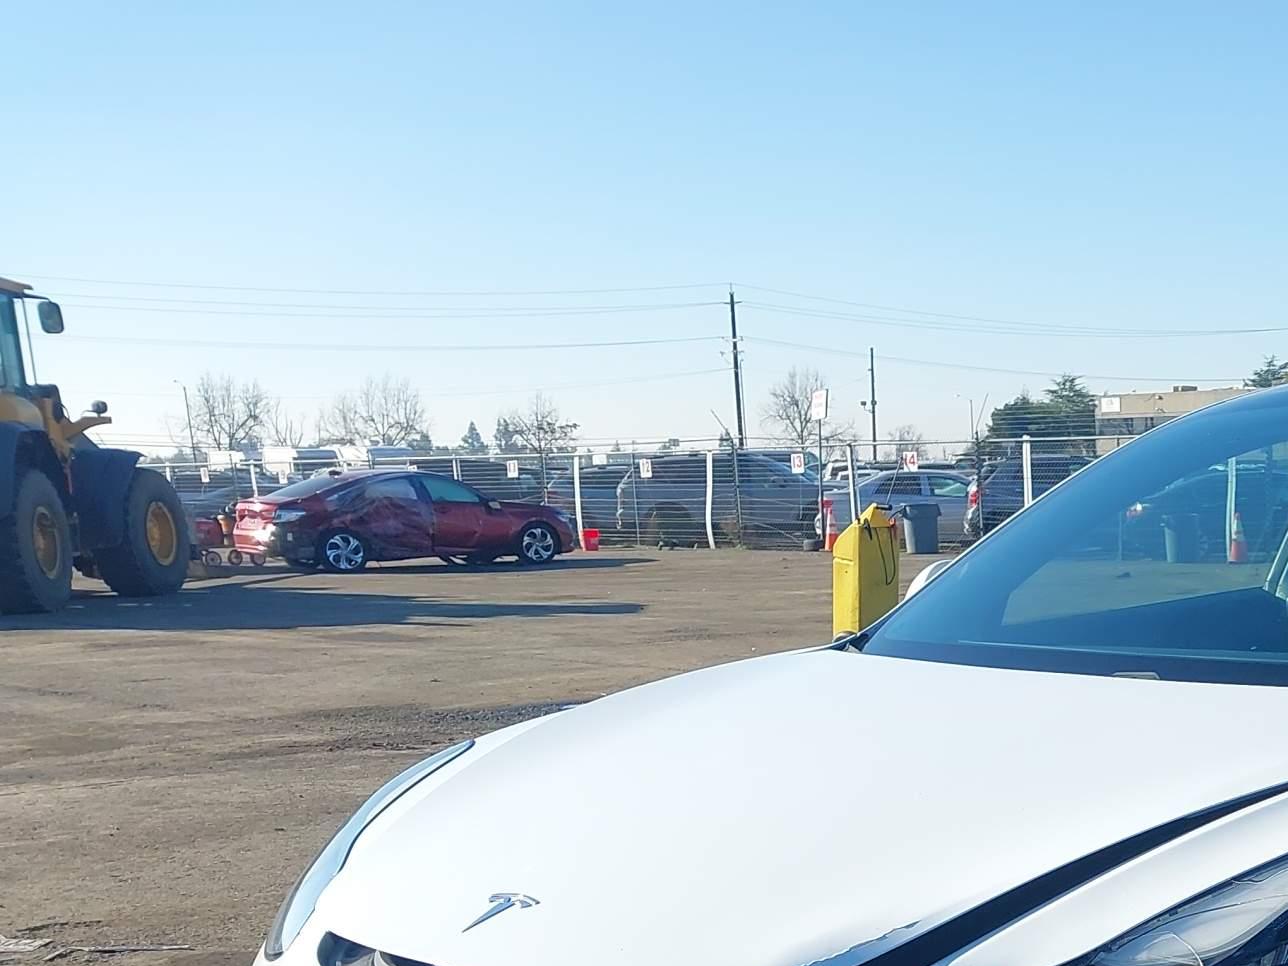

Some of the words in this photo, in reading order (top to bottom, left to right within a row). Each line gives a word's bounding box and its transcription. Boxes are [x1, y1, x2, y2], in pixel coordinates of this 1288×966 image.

[642, 459, 651, 473] 12
[792, 455, 803, 468] 13
[904, 452, 916, 466] 14
